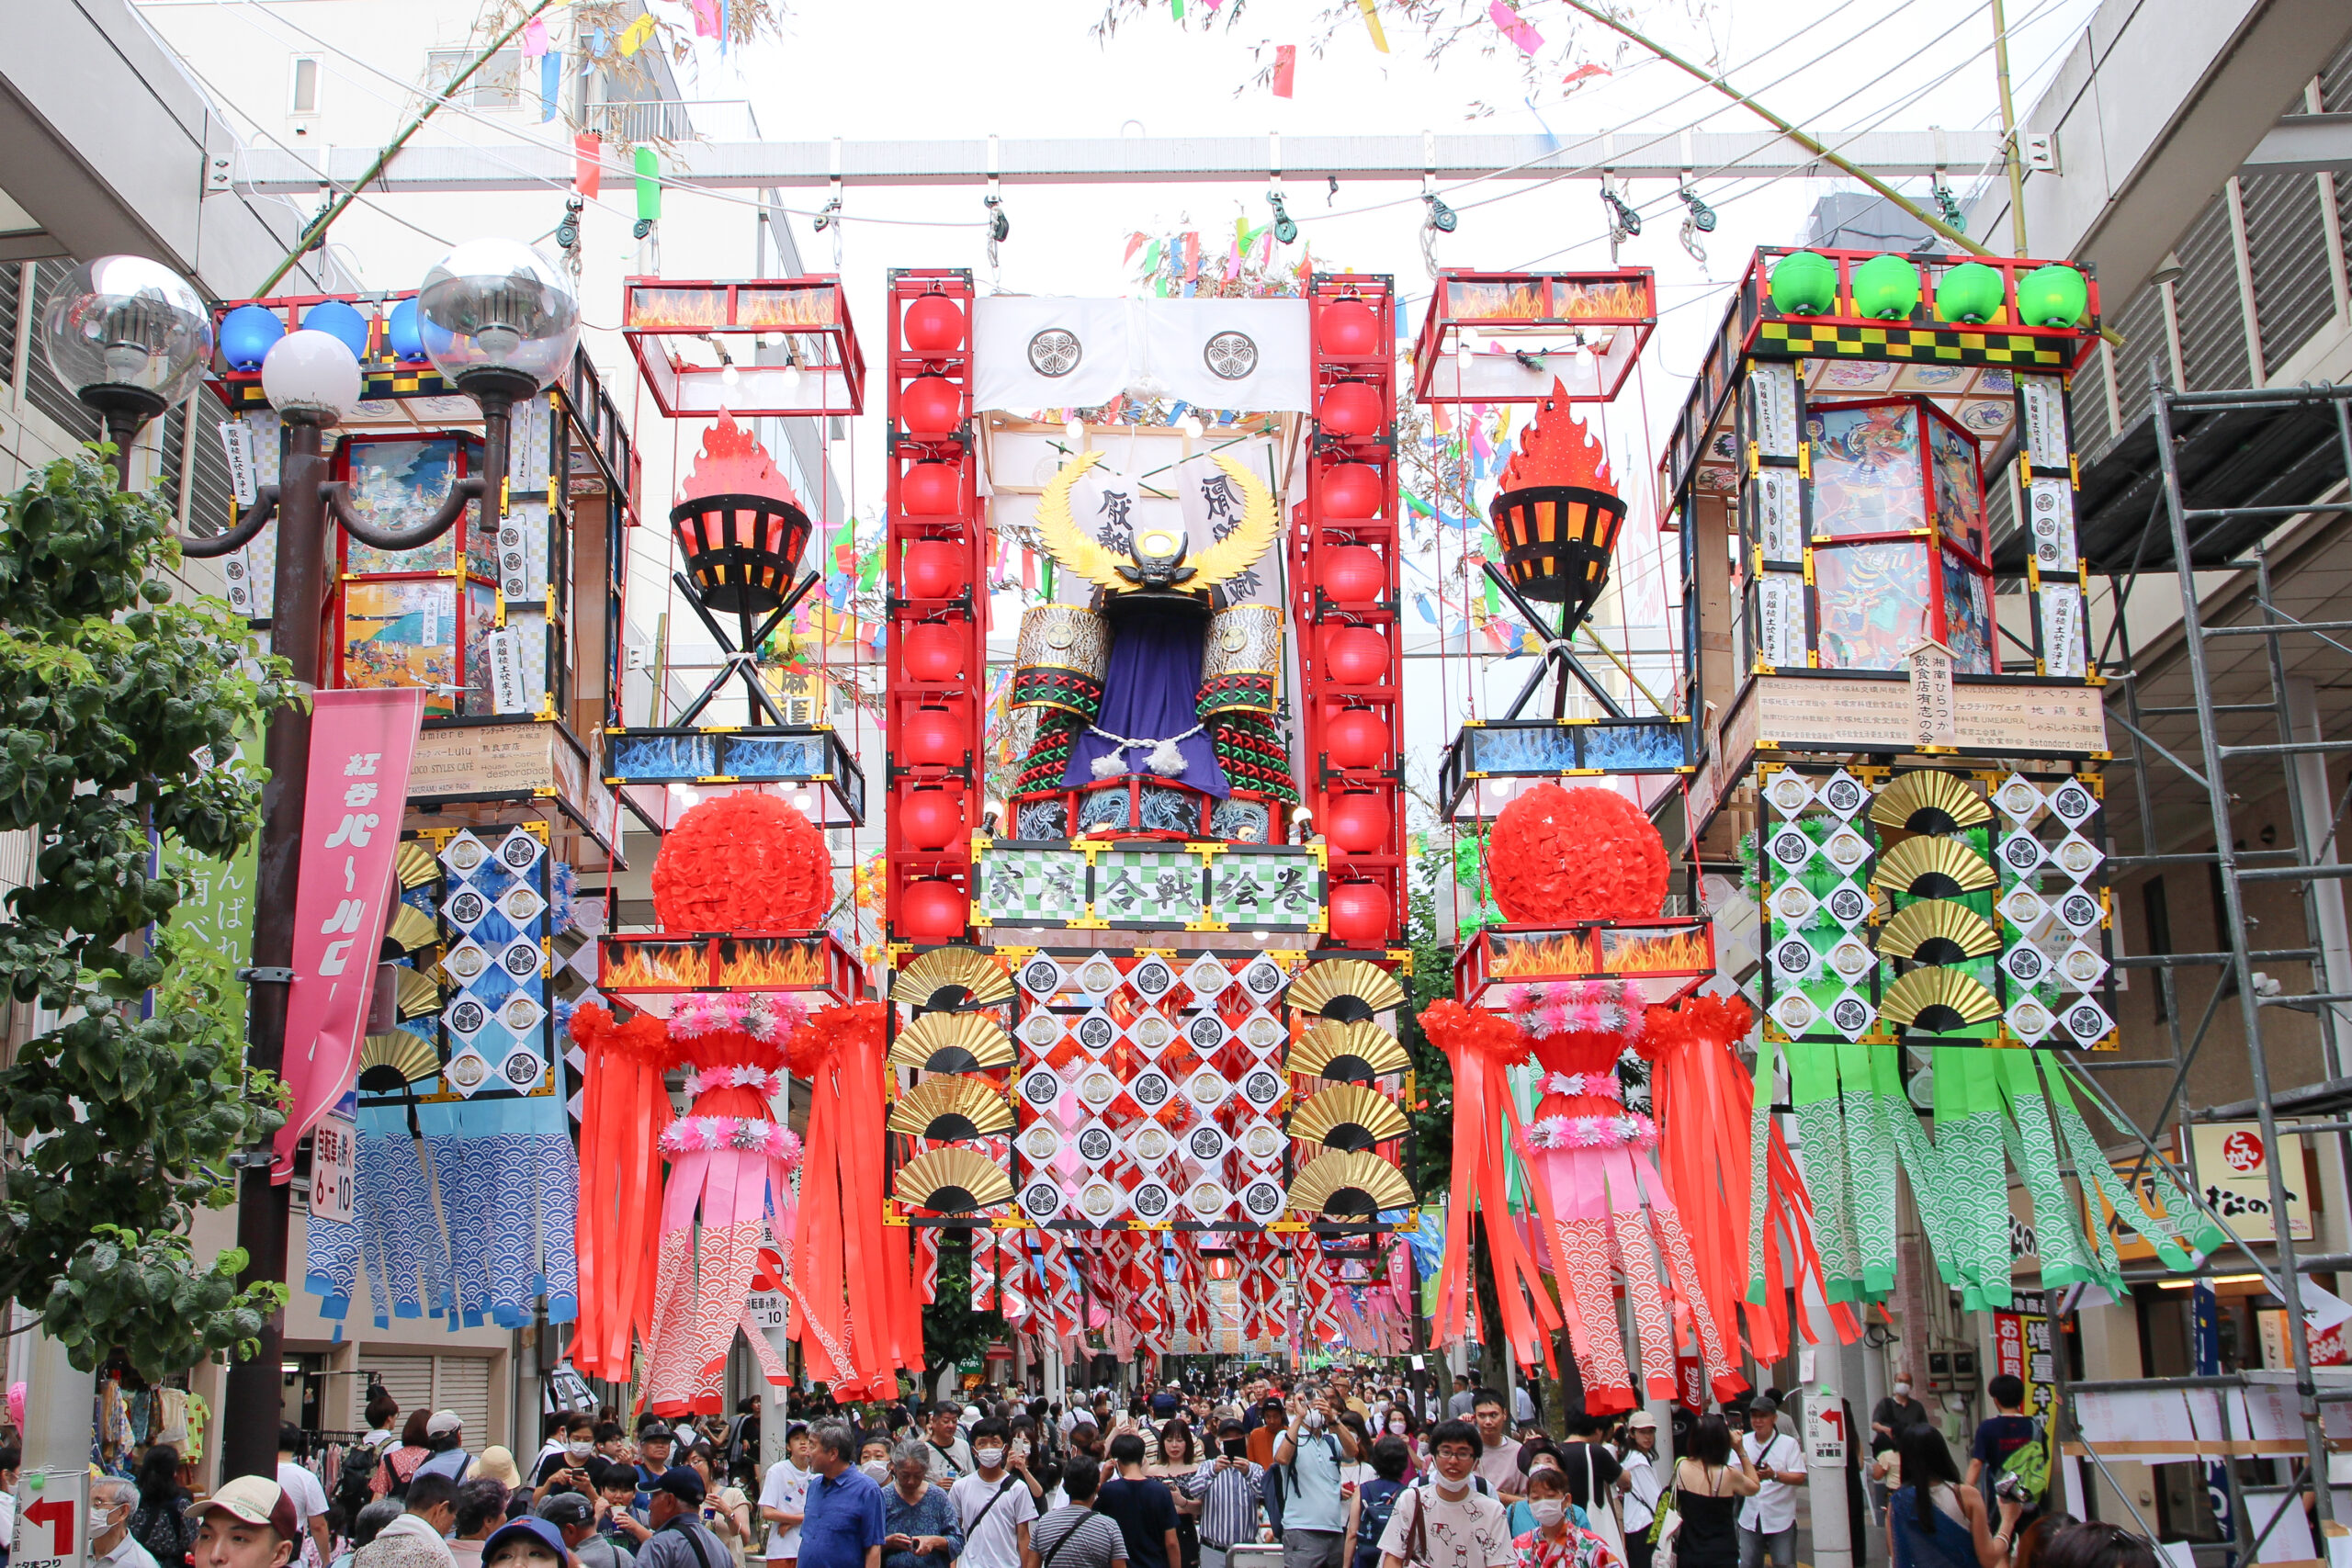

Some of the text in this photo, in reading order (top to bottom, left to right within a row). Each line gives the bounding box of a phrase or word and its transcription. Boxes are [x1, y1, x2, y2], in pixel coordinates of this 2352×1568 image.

[1915, 655, 1934, 744] 飲食店有志の会
[1933, 658, 1948, 730] 湘南ひらつか
[420, 730, 464, 739] umiere
[2030, 739, 2102, 750] 9standard coffee
[432, 763, 456, 773] STYLES
[217, 861, 246, 964] んばれ
[308, 752, 381, 1062] 紅谷パールロ
[2226, 1132, 2258, 1173] とんかつ
[2206, 1185, 2298, 1217] 松の
[758, 1311, 781, 1323] -10
[2002, 1297, 2047, 1314] 象商品
[2000, 1319, 2021, 1379] お値段
